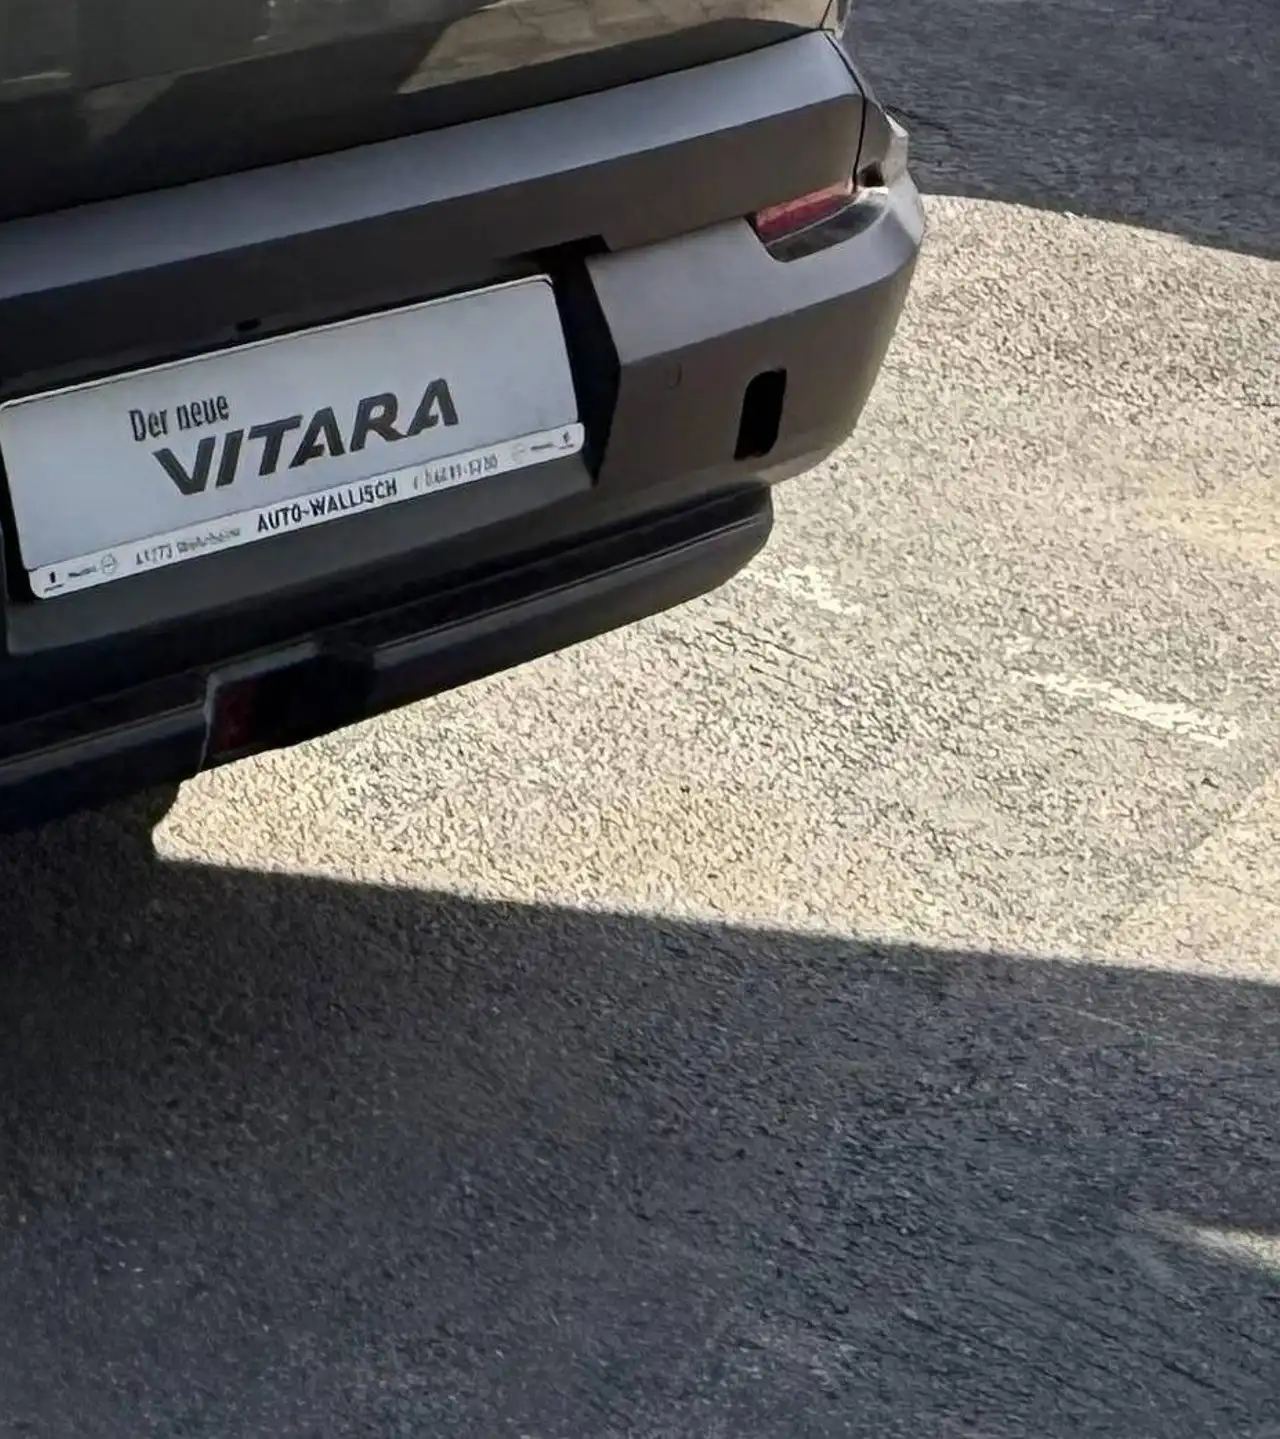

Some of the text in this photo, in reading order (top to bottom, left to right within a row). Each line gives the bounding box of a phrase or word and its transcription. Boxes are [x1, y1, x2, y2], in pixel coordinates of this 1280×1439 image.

[129, 395, 230, 442] Der neue
[152, 377, 459, 496] VITARA
[256, 477, 399, 533] AUTO-WALLISCH
